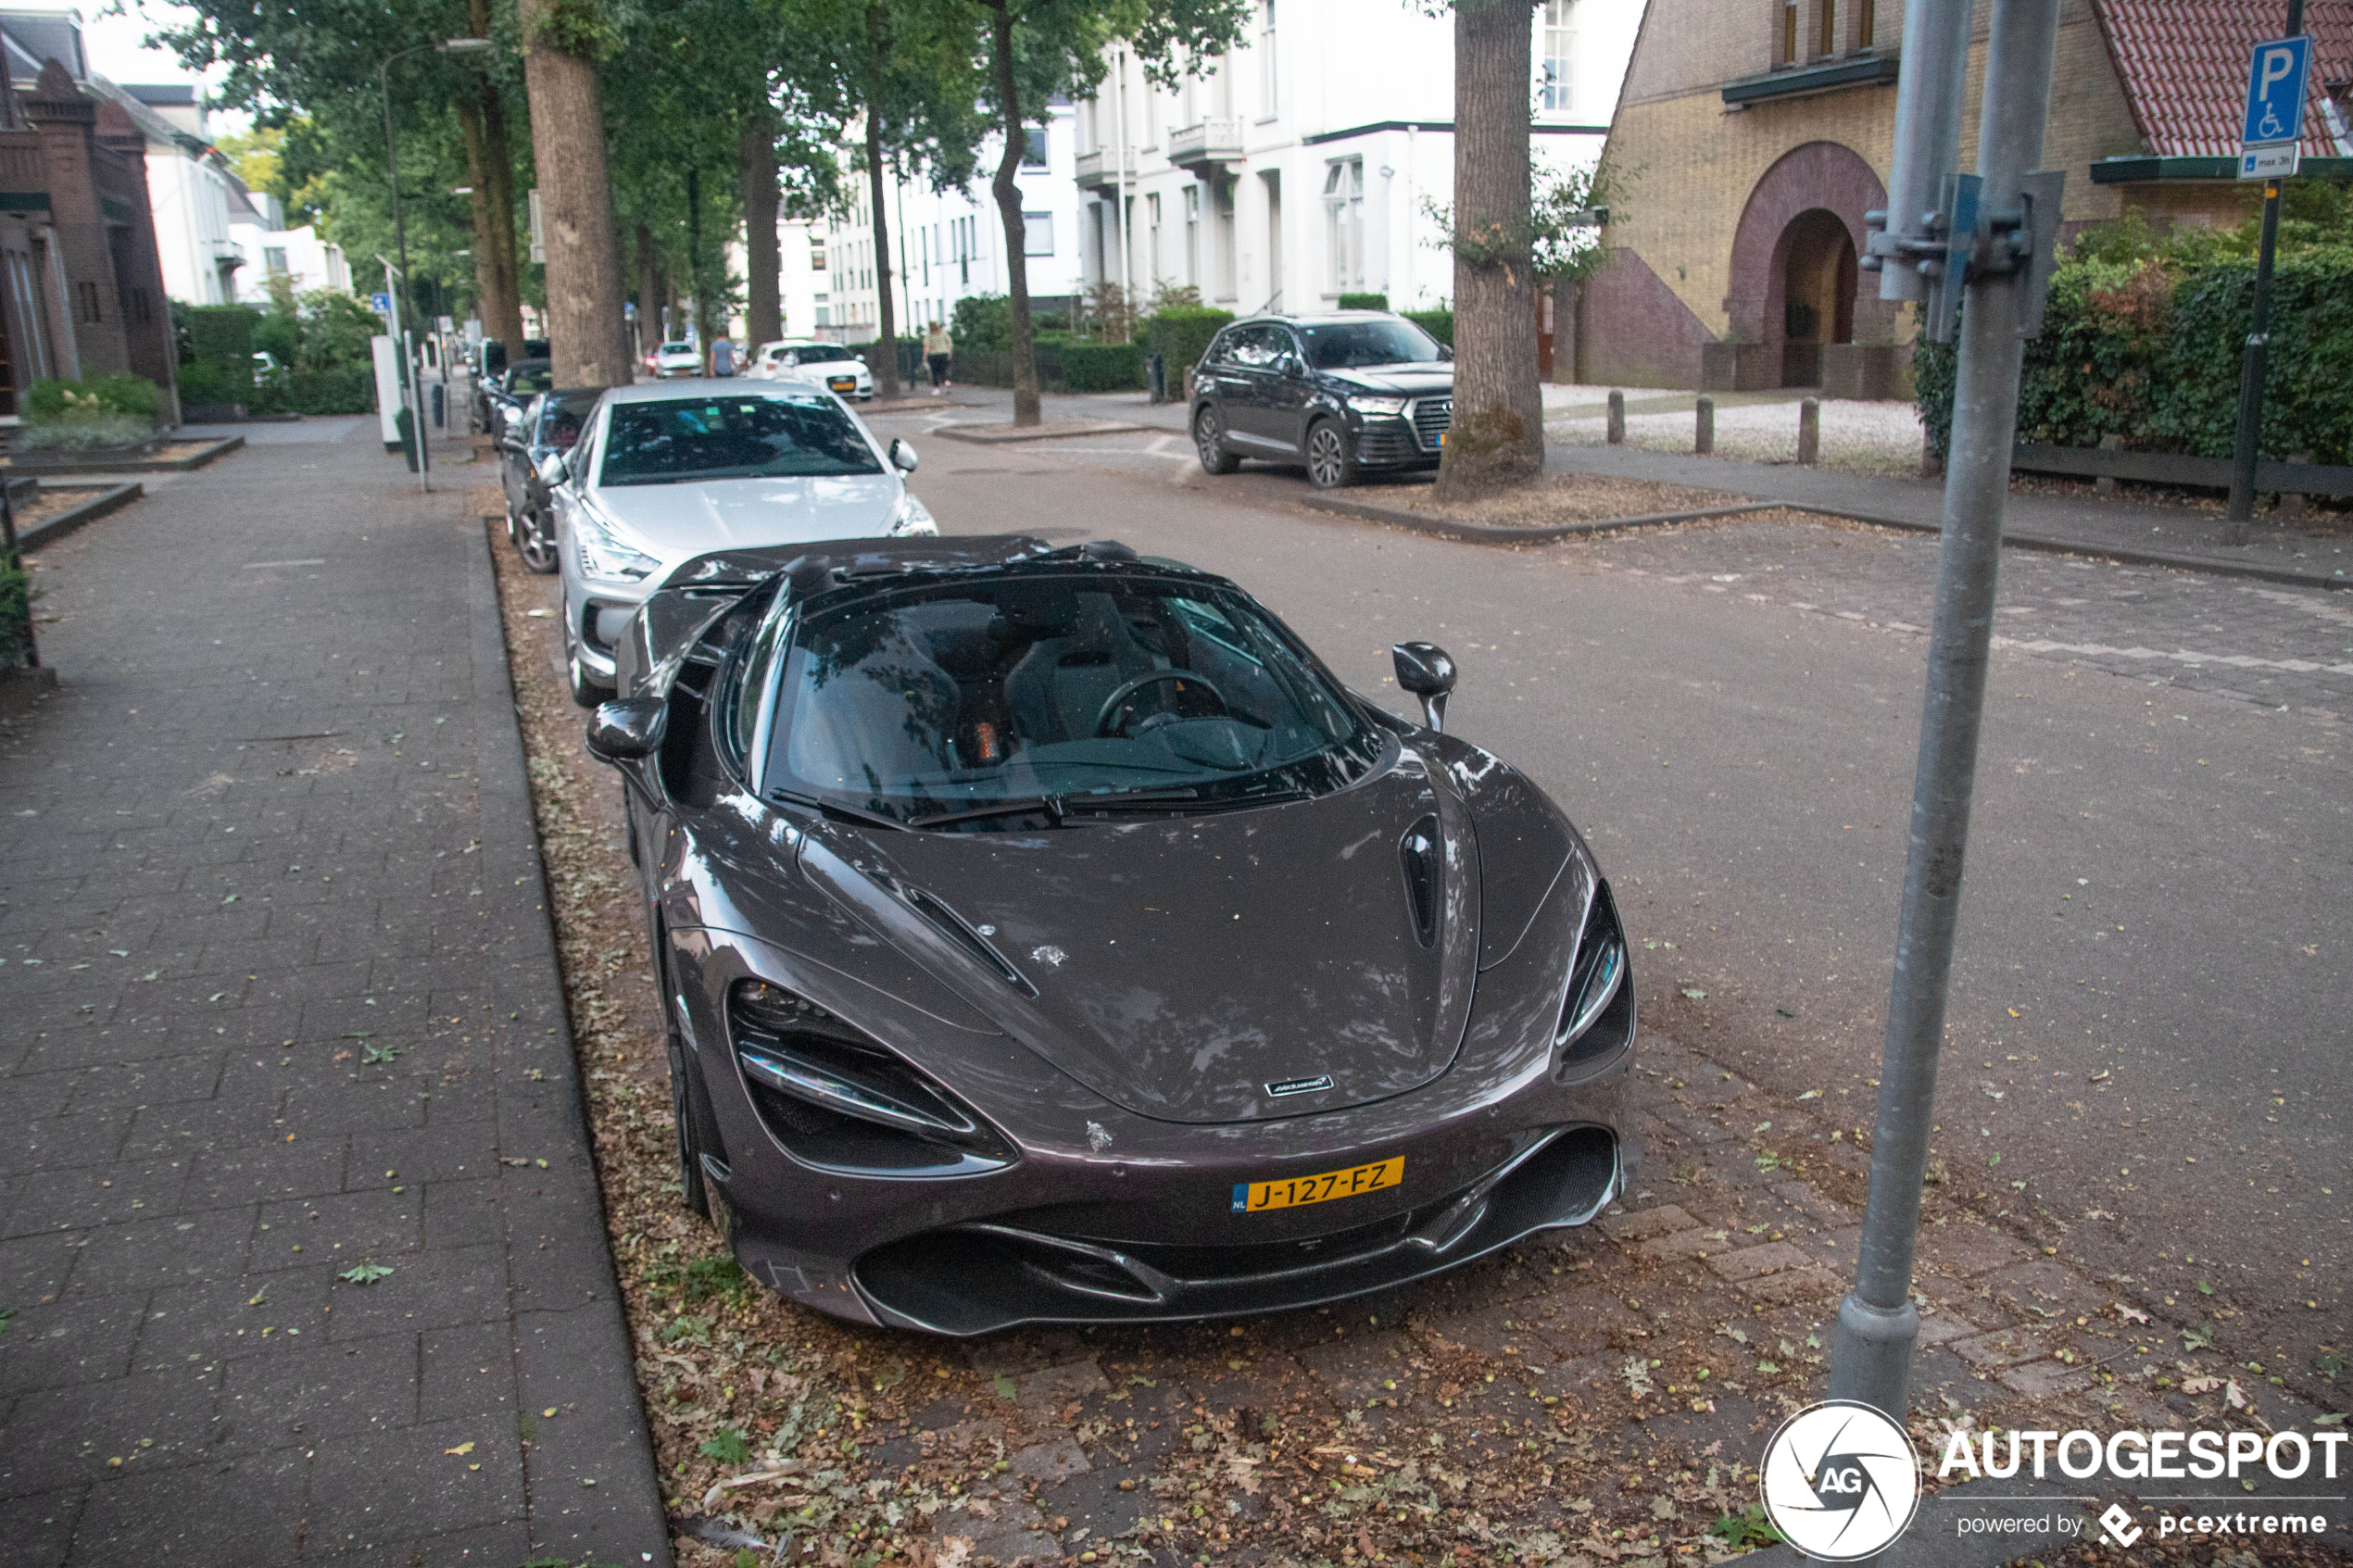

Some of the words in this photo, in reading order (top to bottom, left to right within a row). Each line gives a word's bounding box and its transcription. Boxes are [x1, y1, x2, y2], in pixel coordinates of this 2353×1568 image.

[2259, 47, 2294, 102] P
[1233, 1200, 1246, 1210] NL
[1254, 1163, 1388, 1208] J-127-FZ
